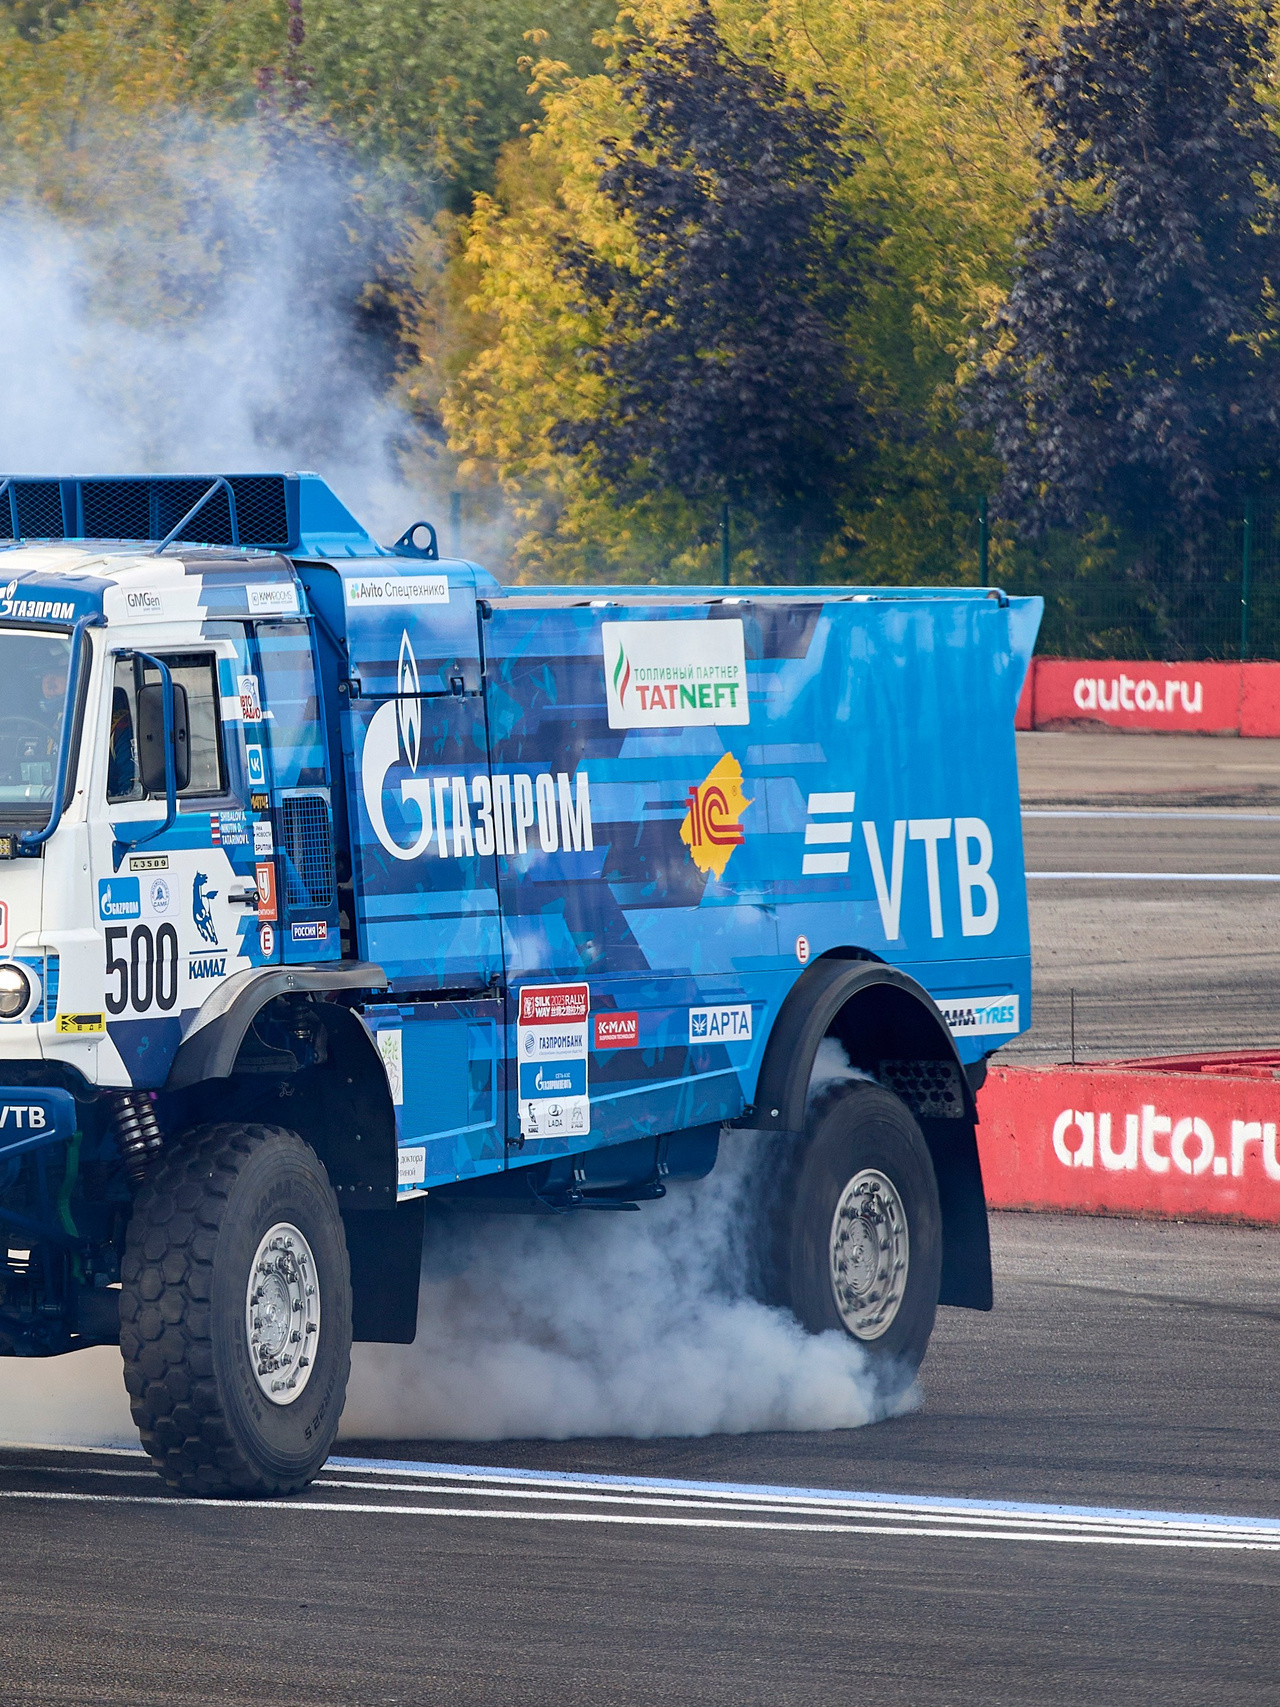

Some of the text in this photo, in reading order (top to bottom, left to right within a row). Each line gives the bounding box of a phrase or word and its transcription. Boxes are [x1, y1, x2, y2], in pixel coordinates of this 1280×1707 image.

[360, 581, 445, 599] Avito Спецтехника
[634, 664, 739, 681] ТОПЛИВНЫЙ ПАРТНЕР
[635, 682, 740, 711] TATNEFT
[1073, 673, 1204, 715] auto.ru
[432, 771, 594, 859] ГАЗПРОМ
[861, 816, 1000, 941] VTB
[294, 926, 316, 937] РОССИЯ
[104, 922, 179, 1015] 500
[188, 957, 227, 980] KAMAZ
[534, 995, 550, 1007] SILK
[535, 1007, 551, 1018] WAY
[539, 1034, 583, 1050] ГАЗПРОМБАНК
[547, 1119, 563, 1128] LADA
